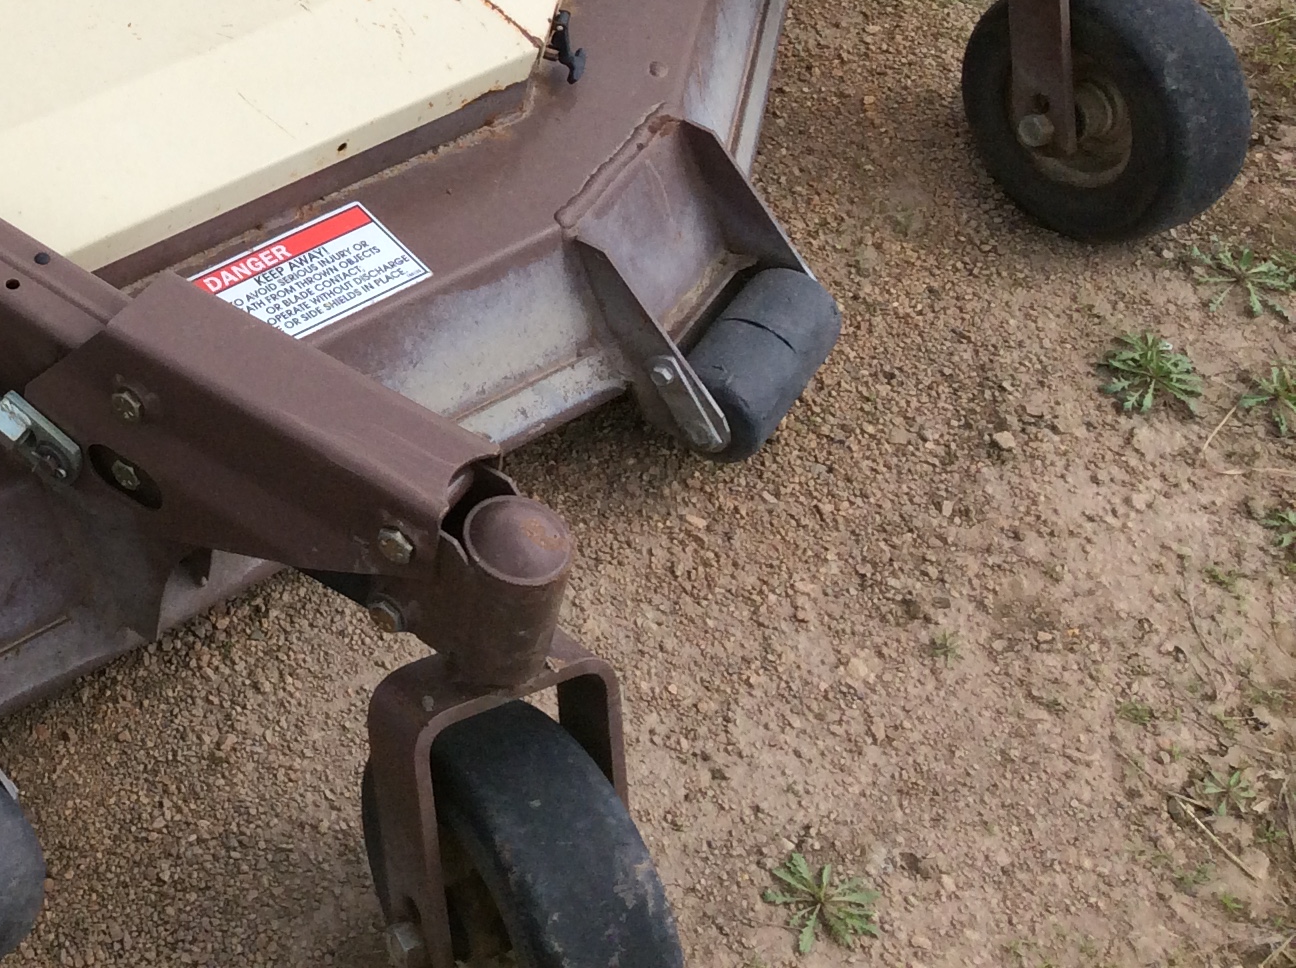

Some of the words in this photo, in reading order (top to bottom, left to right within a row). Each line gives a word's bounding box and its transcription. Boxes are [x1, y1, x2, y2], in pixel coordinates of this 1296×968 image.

[204, 244, 292, 292] DANGER
[233, 297, 244, 309] O
[246, 283, 277, 302] AVOID
[277, 264, 318, 286] SERIOUS
[317, 247, 351, 267] INJURY
[353, 240, 369, 251] OR
[246, 299, 266, 313] ATH
[265, 285, 296, 303] FROM
[294, 265, 339, 289] THROWN
[338, 246, 380, 268] OBJECTS
[253, 266, 284, 286] KEEP
[288, 247, 328, 271] AWAY!
[267, 301, 311, 326] OPERATE
[309, 281, 353, 305] WITHOUT
[352, 253, 409, 285] DISCHARGE
[266, 303, 283, 314] OR
[282, 288, 315, 307] BLADE
[284, 318, 301, 328] OR
[300, 307, 324, 321] SIDE
[323, 289, 362, 310] SHIELDS
[361, 282, 374, 292] IN
